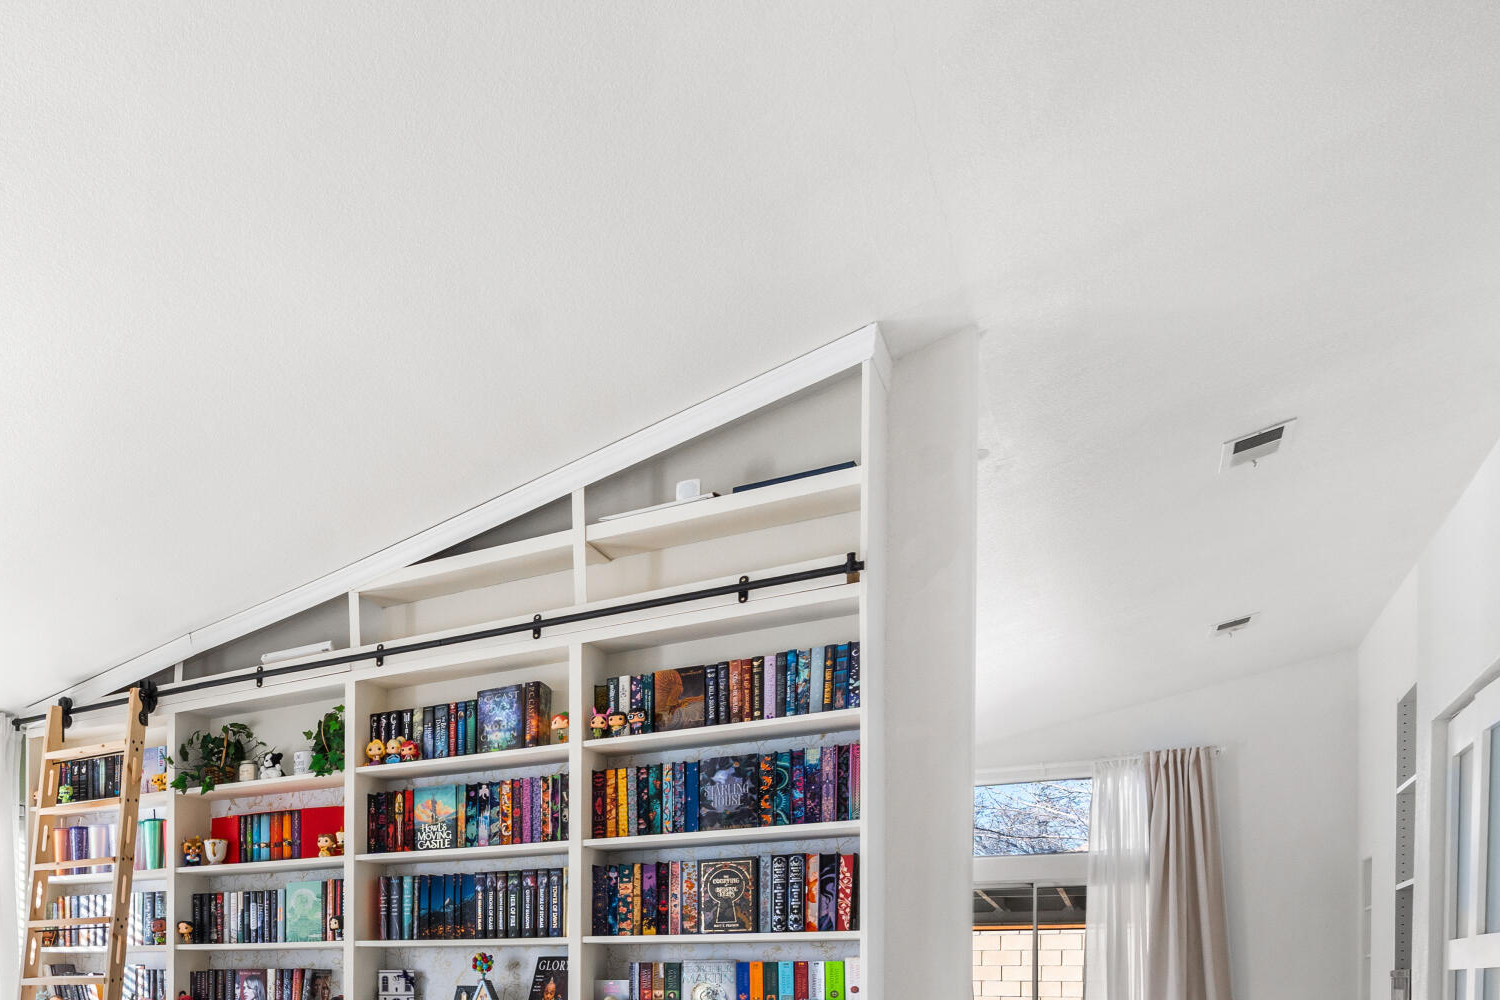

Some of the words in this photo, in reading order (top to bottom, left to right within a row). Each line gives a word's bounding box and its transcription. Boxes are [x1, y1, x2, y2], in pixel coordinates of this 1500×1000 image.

[700, 783, 749, 798] STARLING
[418, 831, 452, 840] MOVING
[418, 839, 451, 850] CASTLE
[682, 973, 734, 984] MARTIN
